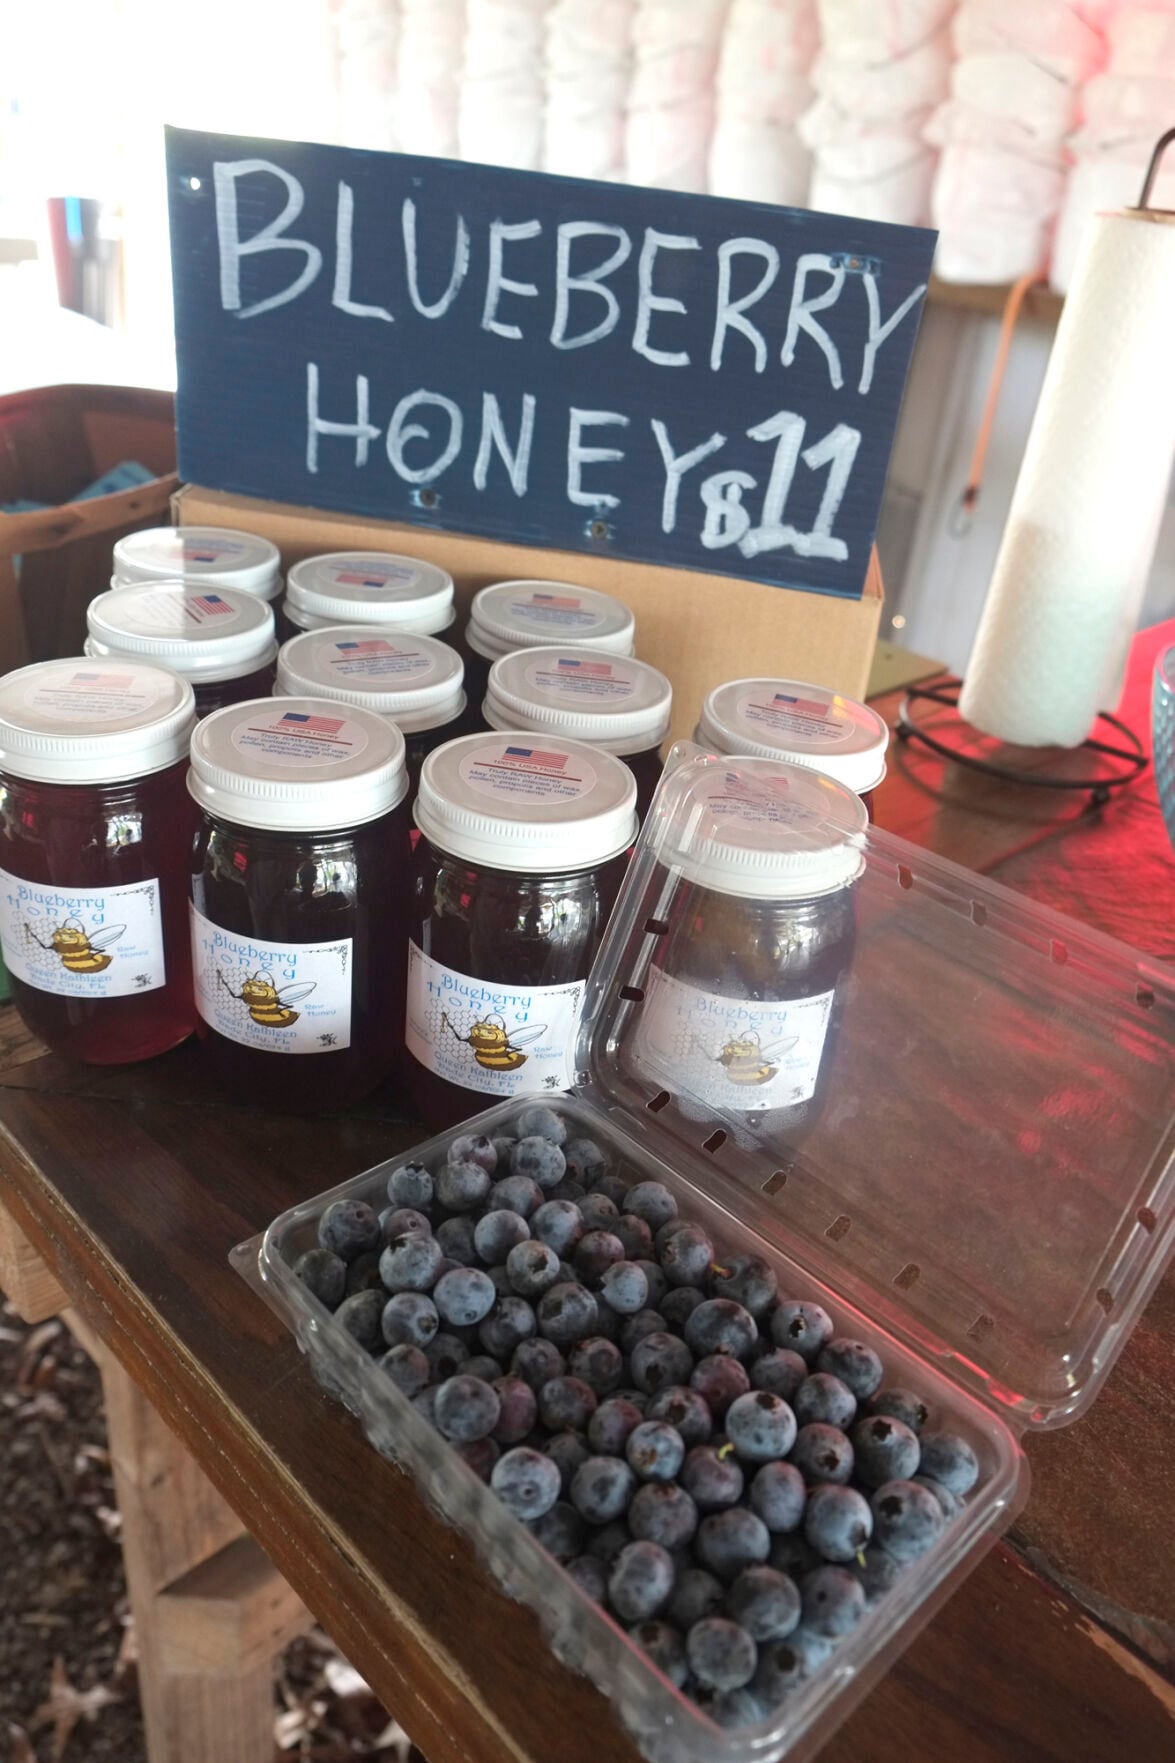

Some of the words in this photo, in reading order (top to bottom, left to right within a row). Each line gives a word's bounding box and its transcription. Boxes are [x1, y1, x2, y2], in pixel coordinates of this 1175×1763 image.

[213, 158, 927, 395] BLUEBERRY
[306, 362, 727, 534] HONEY
[700, 410, 862, 561] $11
[469, 769, 487, 778] May
[489, 773, 521, 782] contain
[521, 777, 550, 787] pieces
[488, 767, 508, 776] Truly
[534, 774, 563, 784] Honey
[518, 762, 538, 770] USA
[539, 766, 568, 776] Honey
[535, 785, 553, 793] and
[553, 788, 577, 797] other
[17, 884, 106, 911] Blueberry
[213, 931, 298, 967] Blueberry
[441, 973, 532, 1009] Blueberry
[695, 997, 788, 1022] Blueberry
